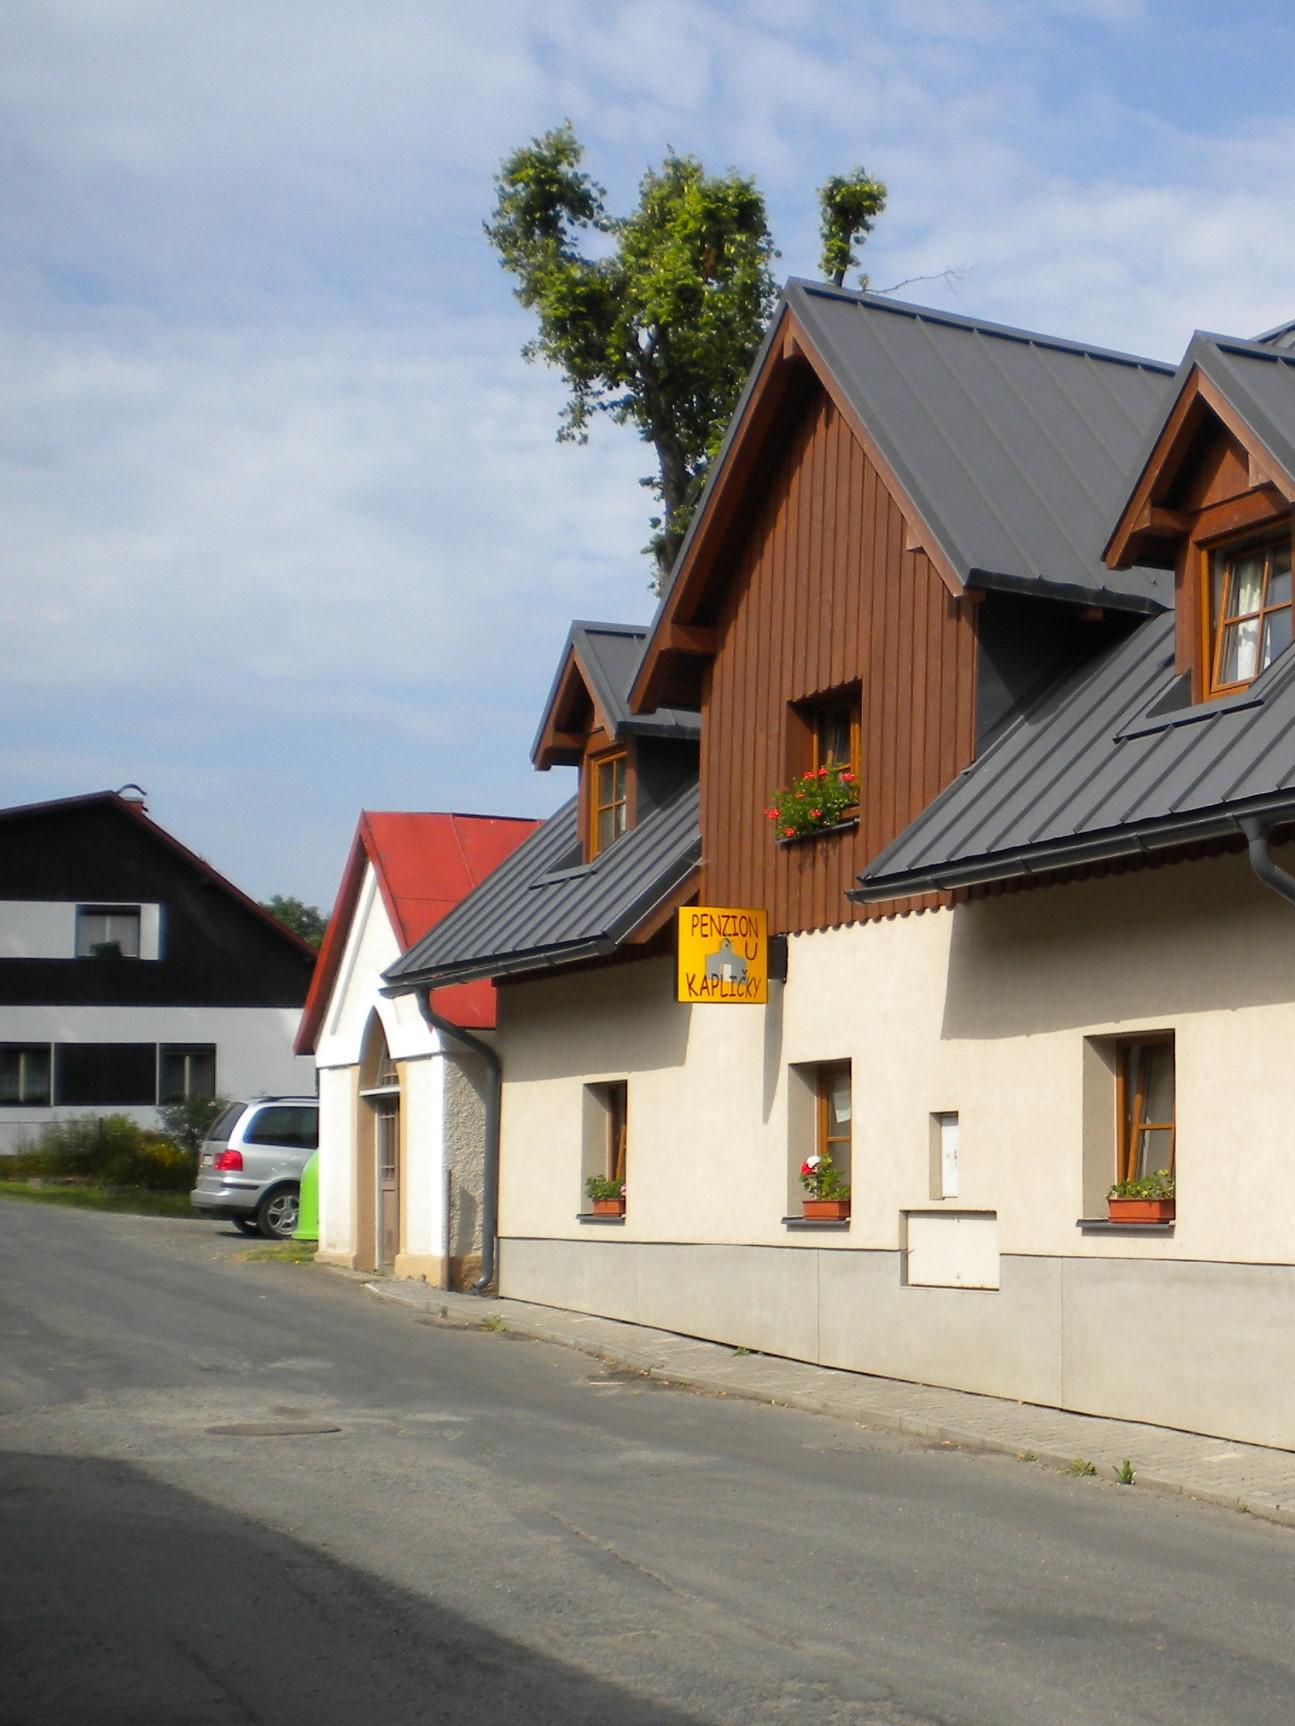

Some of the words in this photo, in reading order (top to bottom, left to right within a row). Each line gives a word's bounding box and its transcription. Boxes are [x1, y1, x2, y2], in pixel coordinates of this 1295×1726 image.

[691, 913, 759, 938] PENZION
[744, 941, 758, 961] U
[686, 968, 762, 998] KAPLIČKY
